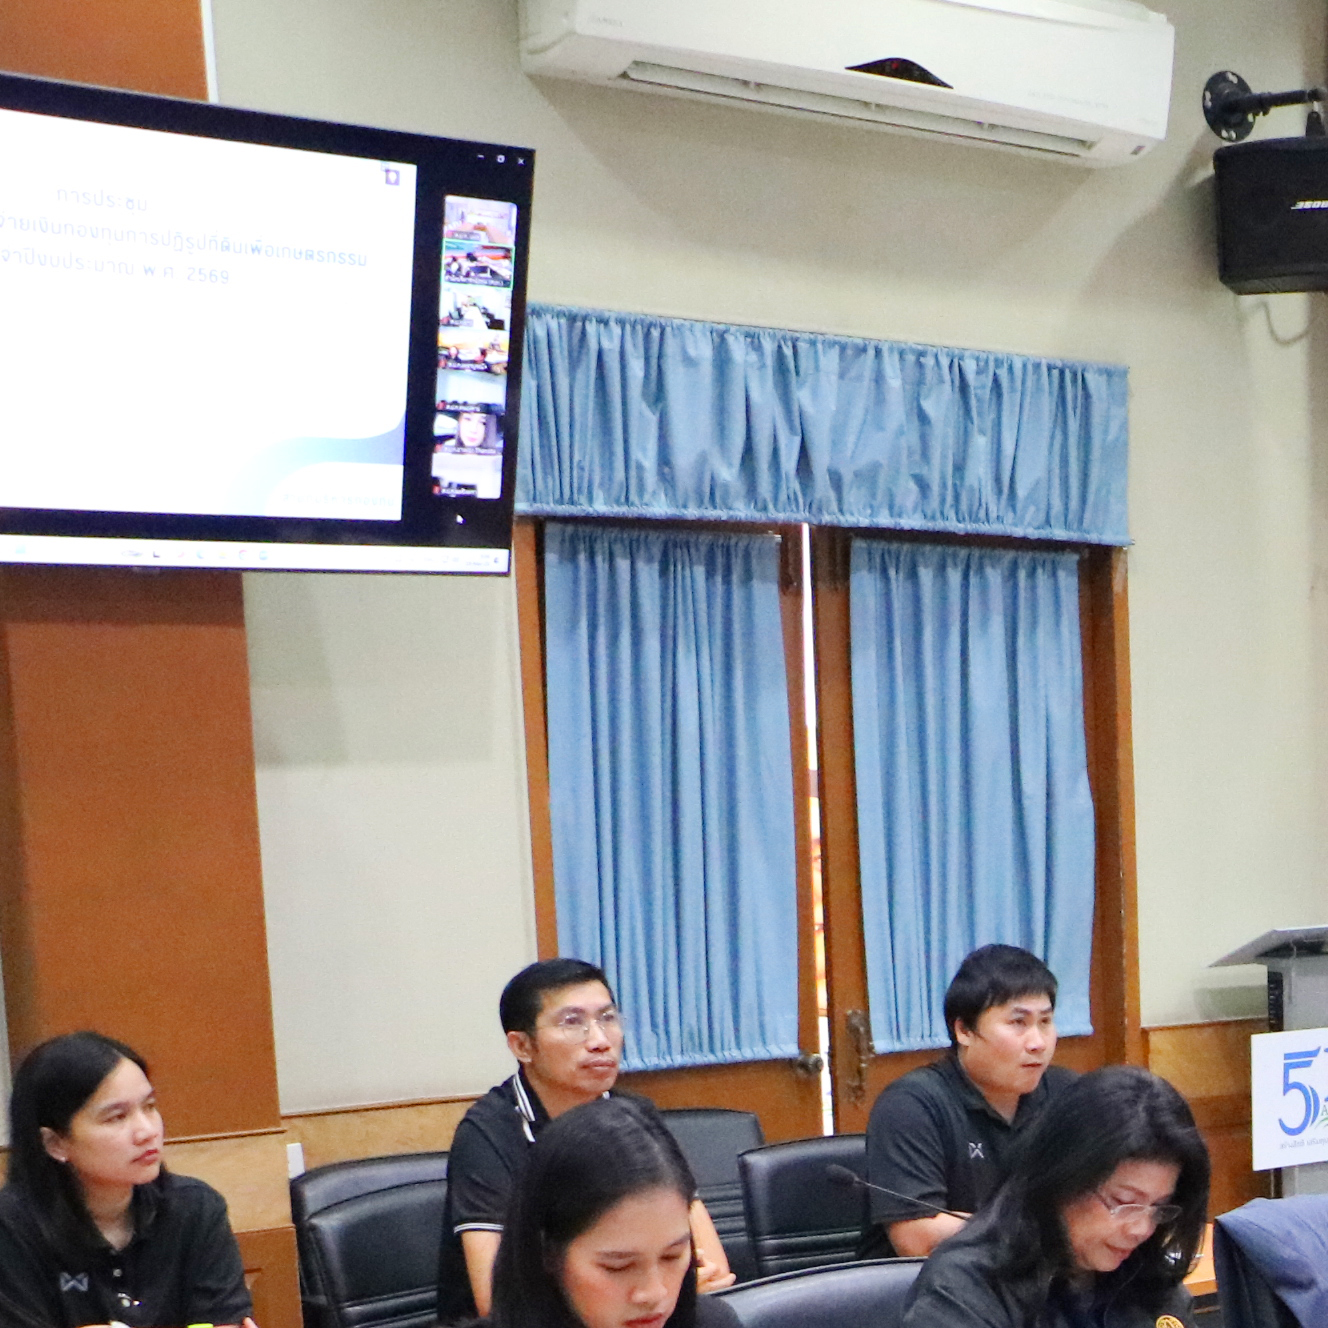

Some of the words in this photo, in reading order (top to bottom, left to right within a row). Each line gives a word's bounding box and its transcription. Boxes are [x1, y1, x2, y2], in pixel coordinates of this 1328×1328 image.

[57, 187, 148, 216] การประชุม
[187, 266, 230, 287] 2569
